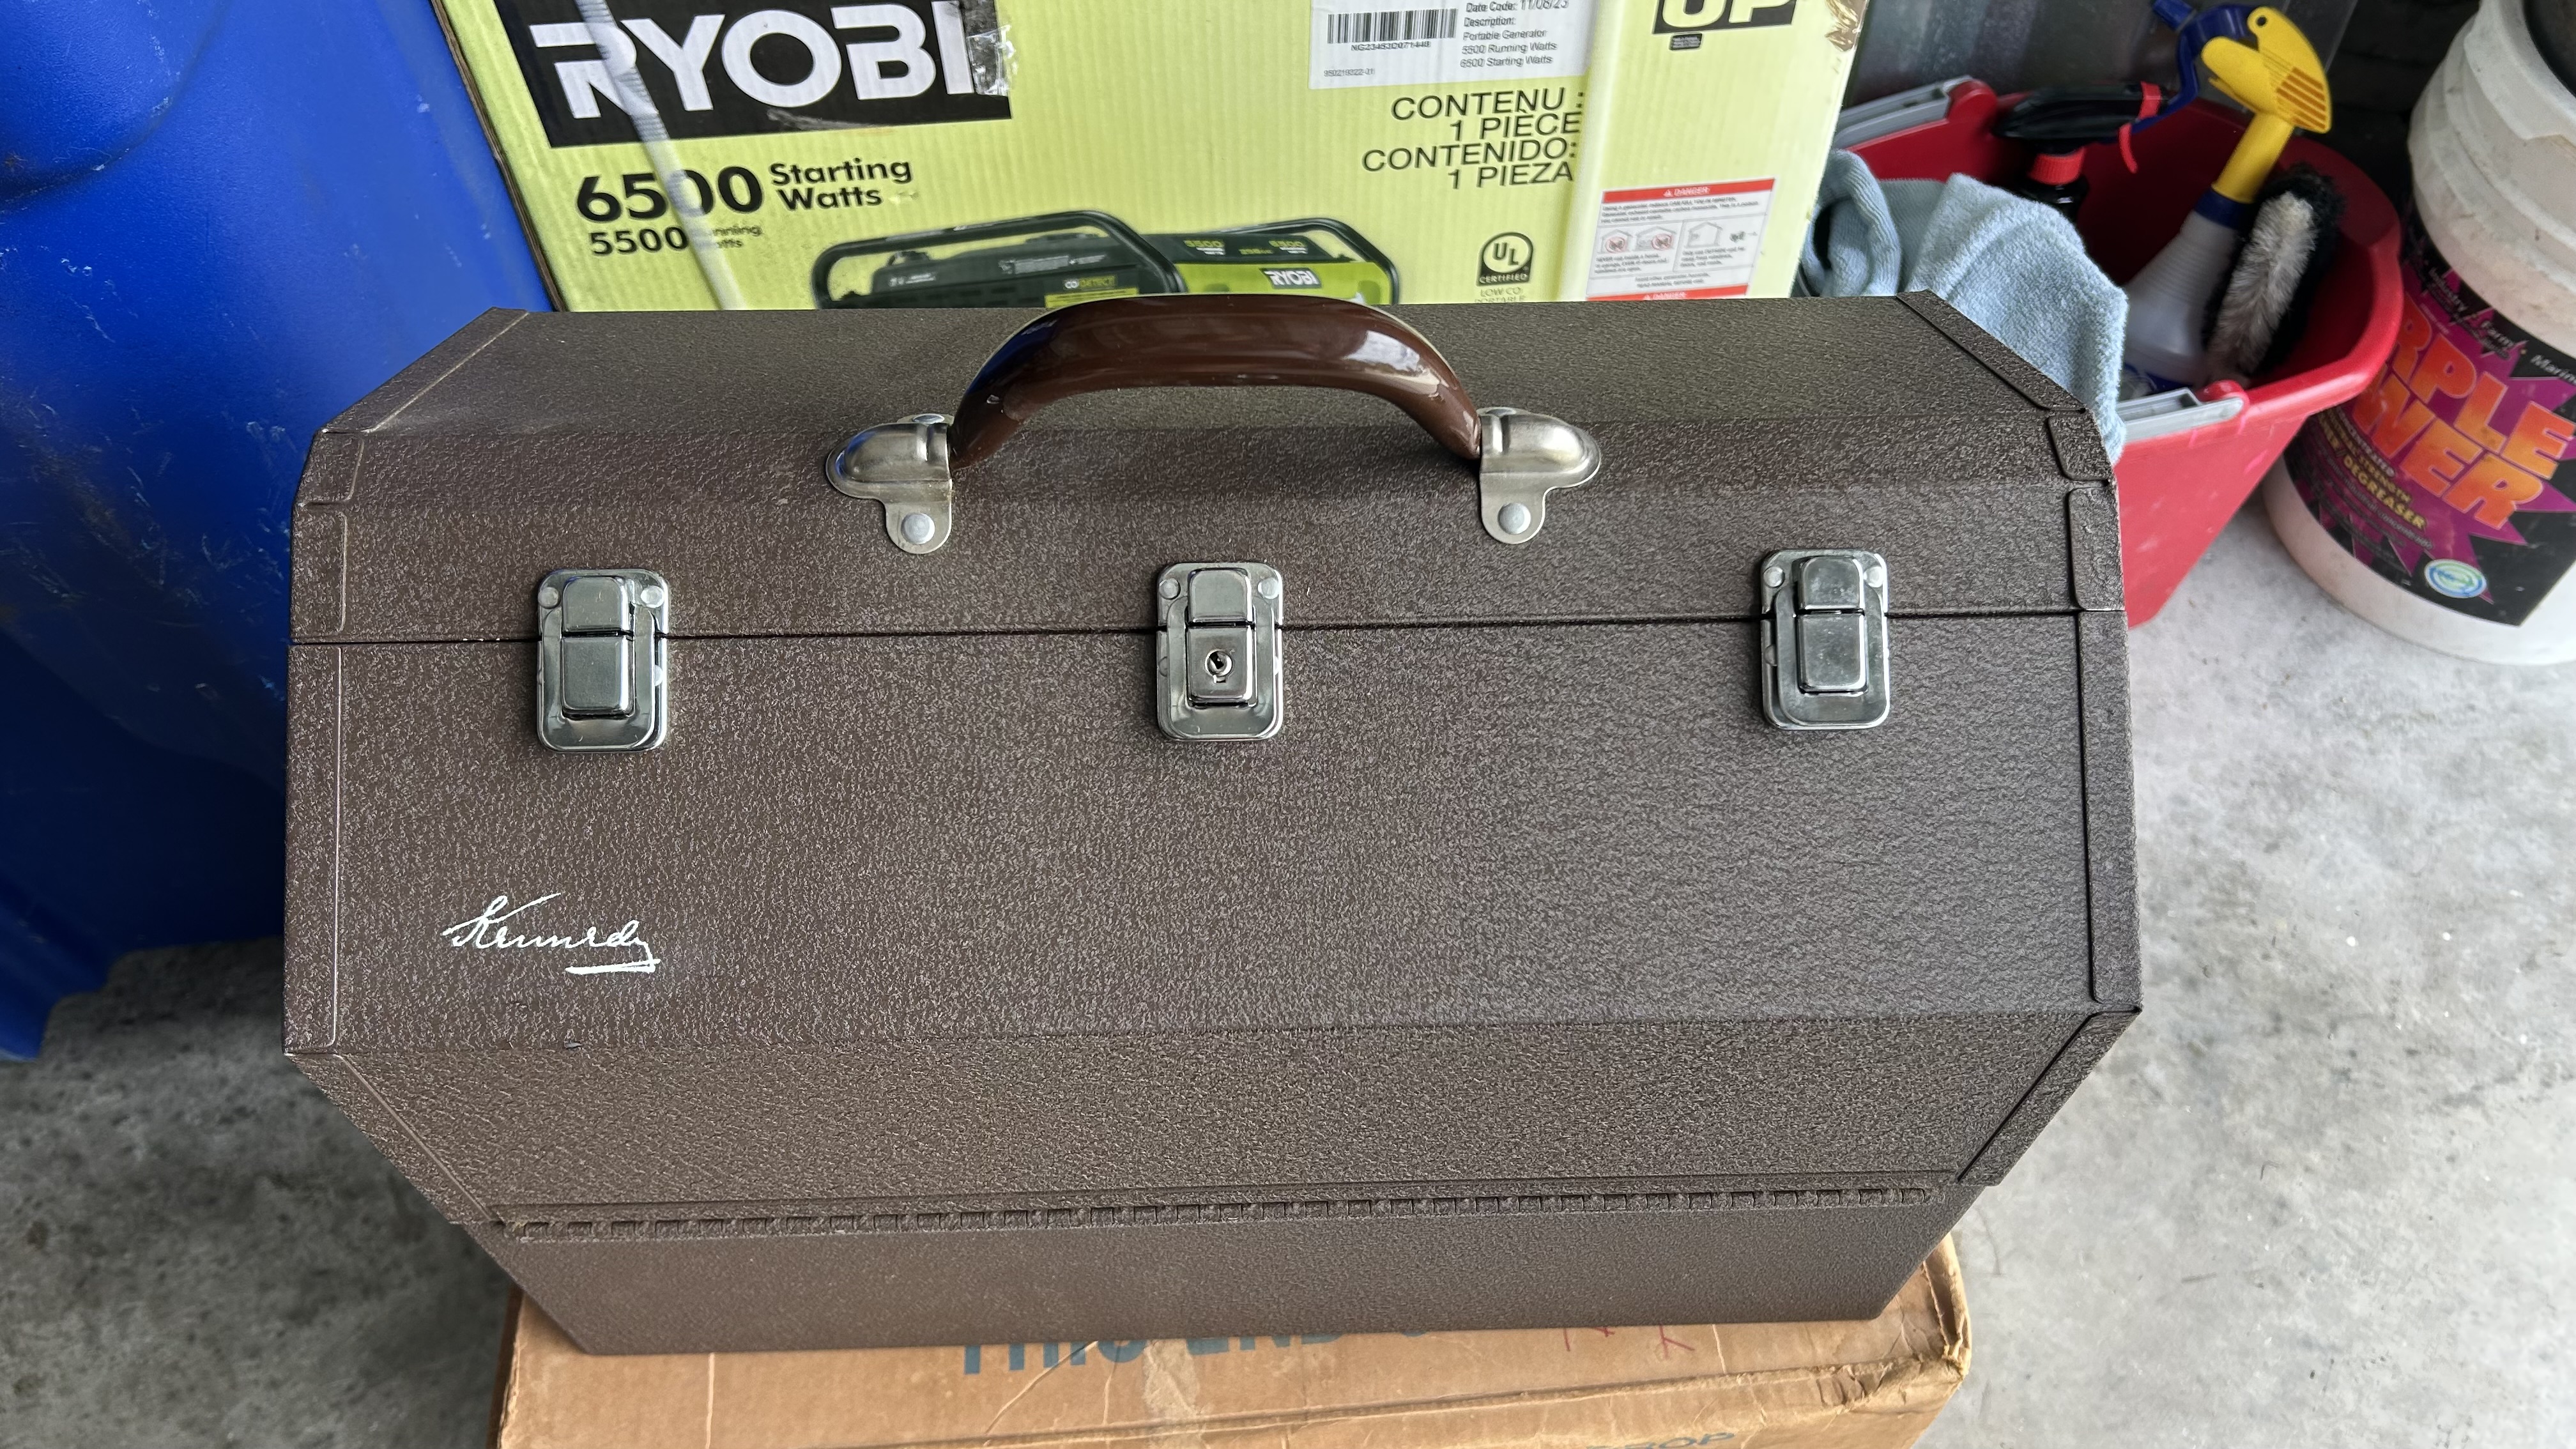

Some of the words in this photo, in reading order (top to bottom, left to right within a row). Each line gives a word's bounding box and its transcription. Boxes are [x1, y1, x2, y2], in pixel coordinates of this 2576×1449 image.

[1463, 15, 1517, 27] Description:
[1466, 2, 1488, 13] Date
[1489, 1, 1518, 12] Code:
[1462, 31, 1501, 41] Portable
[1502, 29, 1547, 40] Generator
[1487, 43, 1528, 54] Running
[1529, 41, 1558, 51] Watts
[529, 0, 974, 119] RYOBI
[1486, 56, 1524, 68] Starting
[1525, 55, 1554, 64] Watts
[1450, 119, 1462, 141] 1
[1479, 108, 1583, 140] PIÈCE
[1361, 136, 1577, 172] CONTENIDO:
[770, 157, 912, 187] Starting
[1447, 169, 1461, 190] 1
[1476, 160, 1574, 188] PIEZA
[576, 165, 765, 222] 6500
[775, 187, 884, 211] Watts
[589, 226, 689, 256] 5500
[712, 224, 762, 237] nning
[1492, 242, 1519, 266] UL
[1263, 270, 1319, 286] RYOBI
[1479, 273, 1528, 284] CERTIFIED
[1480, 287, 1505, 298] LOW
[1505, 286, 1523, 295] CO
[2480, 319, 2515, 348] Farm
[2393, 289, 2576, 481] RPLE
[2352, 362, 2545, 531] WER
[2343, 454, 2426, 532] DEGREASER
[443, 892, 661, 974] Kennedy
